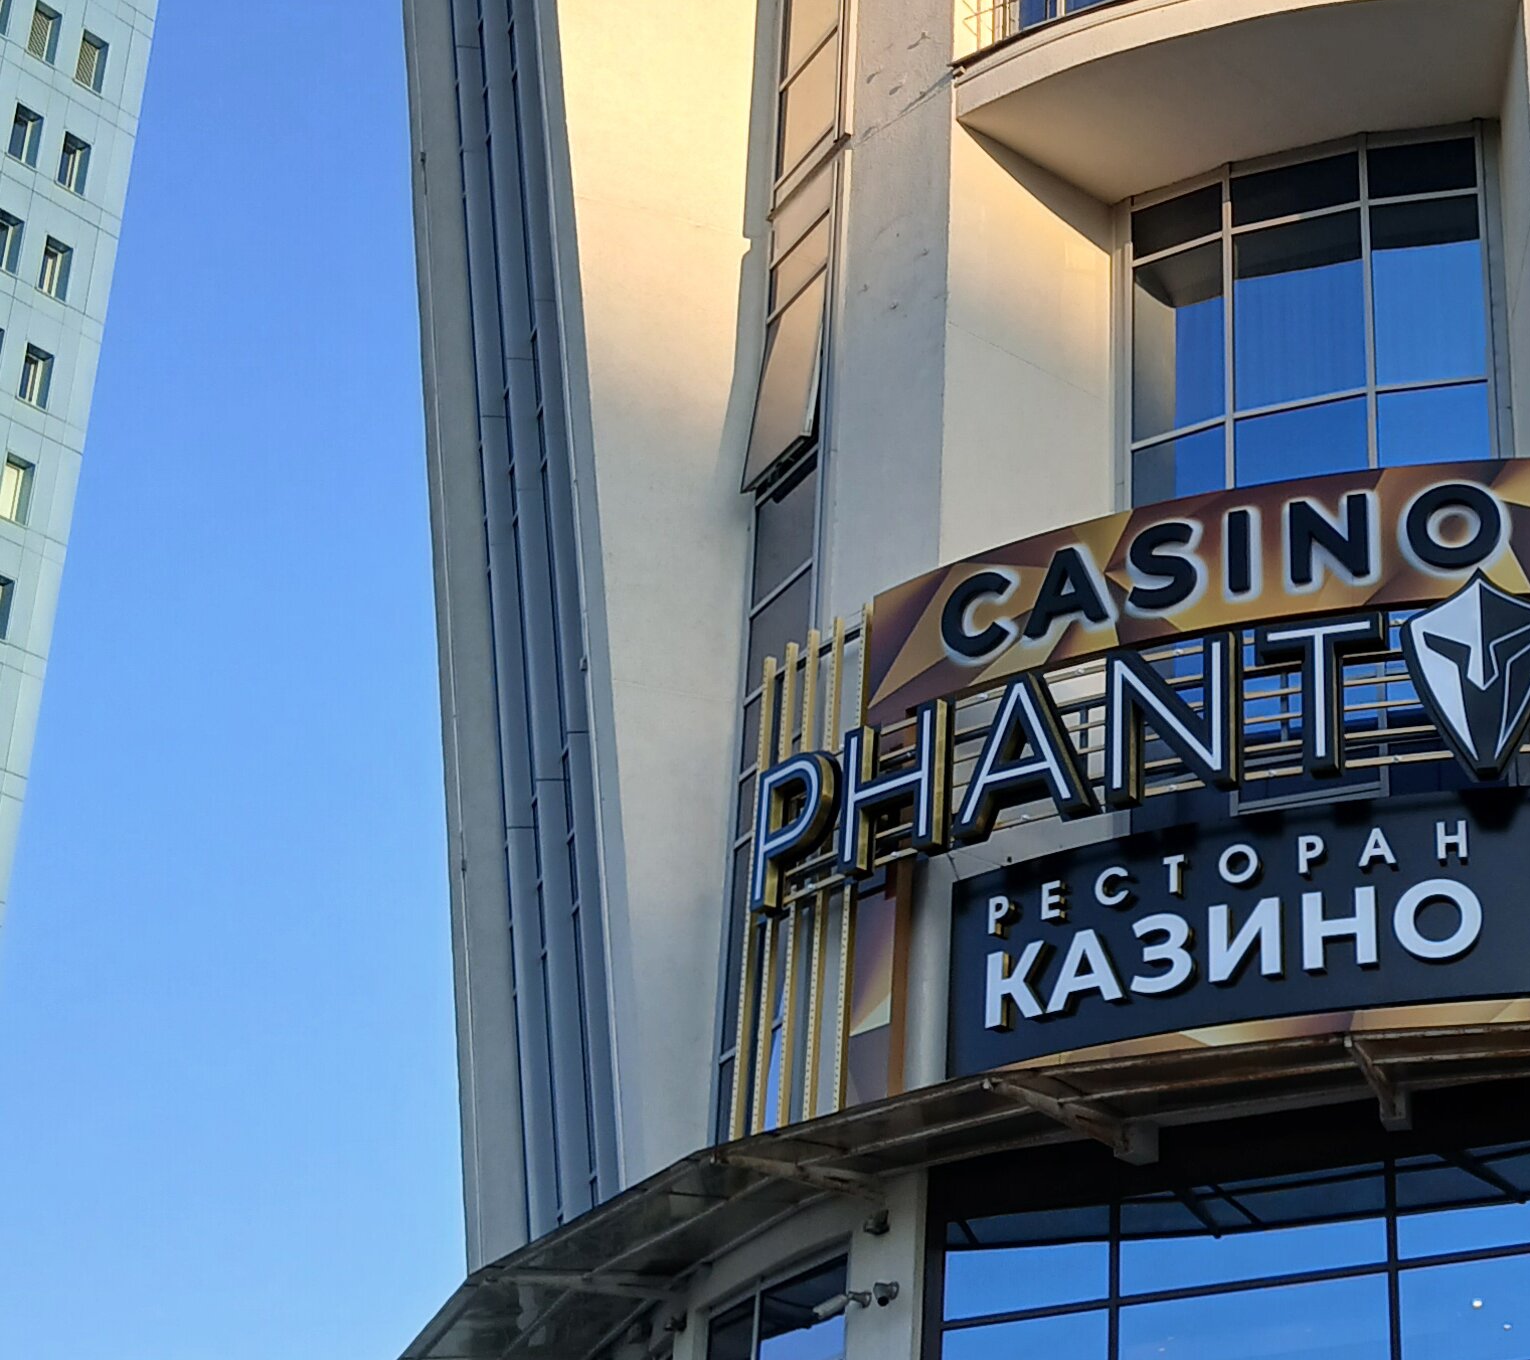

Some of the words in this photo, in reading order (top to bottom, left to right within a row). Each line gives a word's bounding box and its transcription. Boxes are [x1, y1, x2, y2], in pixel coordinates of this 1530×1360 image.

[939, 482, 1503, 659] CASINO
[987, 819, 1471, 936] РЕСТОРАН
[984, 878, 1484, 1032] КАЗИНО
